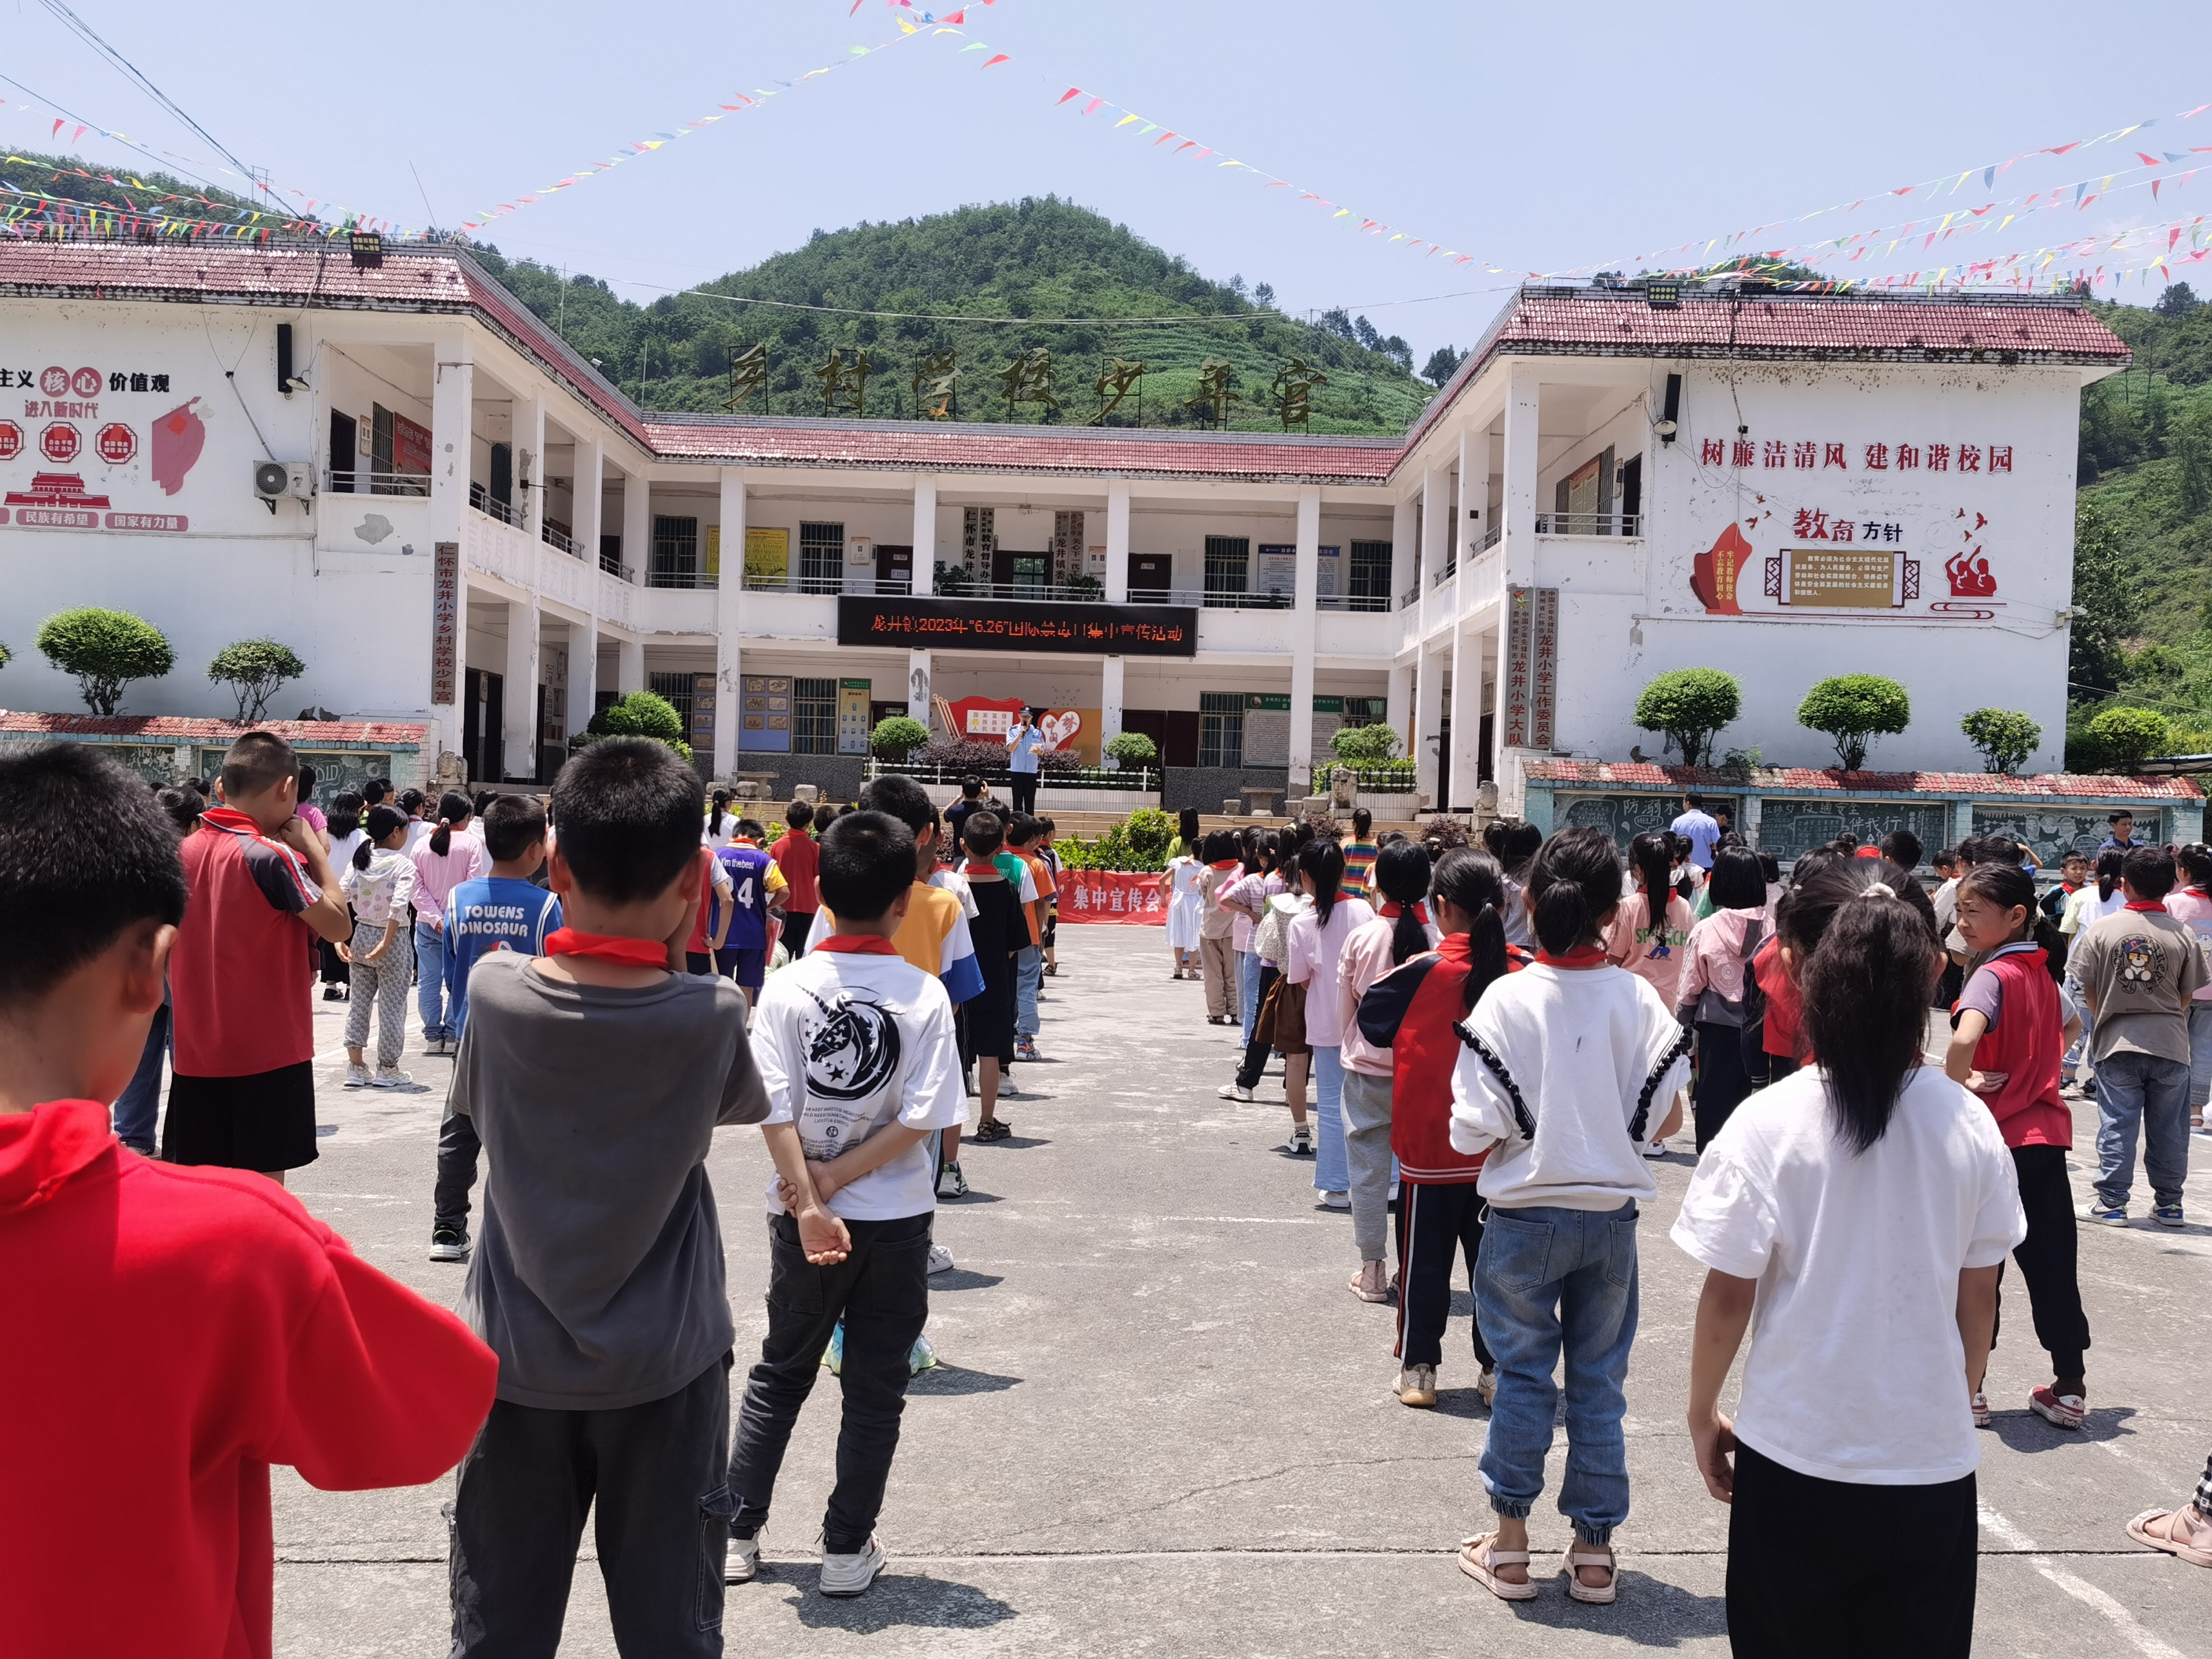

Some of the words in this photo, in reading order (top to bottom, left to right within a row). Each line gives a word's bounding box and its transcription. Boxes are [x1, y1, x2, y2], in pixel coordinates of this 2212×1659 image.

[25, 400, 98, 419] 进入新时代
[1701, 439, 1848, 470] 树廉洁清风
[1865, 442, 2014, 472] 建和谐校园
[25, 511, 89, 526] 民族有希望
[115, 515, 178, 529] 国家有力量
[435, 546, 455, 701] 仁怀市龙井小学乡村学校少年宫
[1547, 591, 1556, 634] 中国少年先锋队
[1511, 611, 1520, 659] 贵州省仁怀市
[1521, 611, 1529, 660] 中国少年先锋队
[1509, 661, 1526, 745] 龙井小学大队
[1535, 635, 1553, 745] 龙井小学工作委员会
[1623, 799, 1681, 817] 防溺水
[1849, 816, 1903, 834] 伴我行
[464, 905, 525, 920] TOWENS
[460, 921, 528, 937] DINOSAUR
